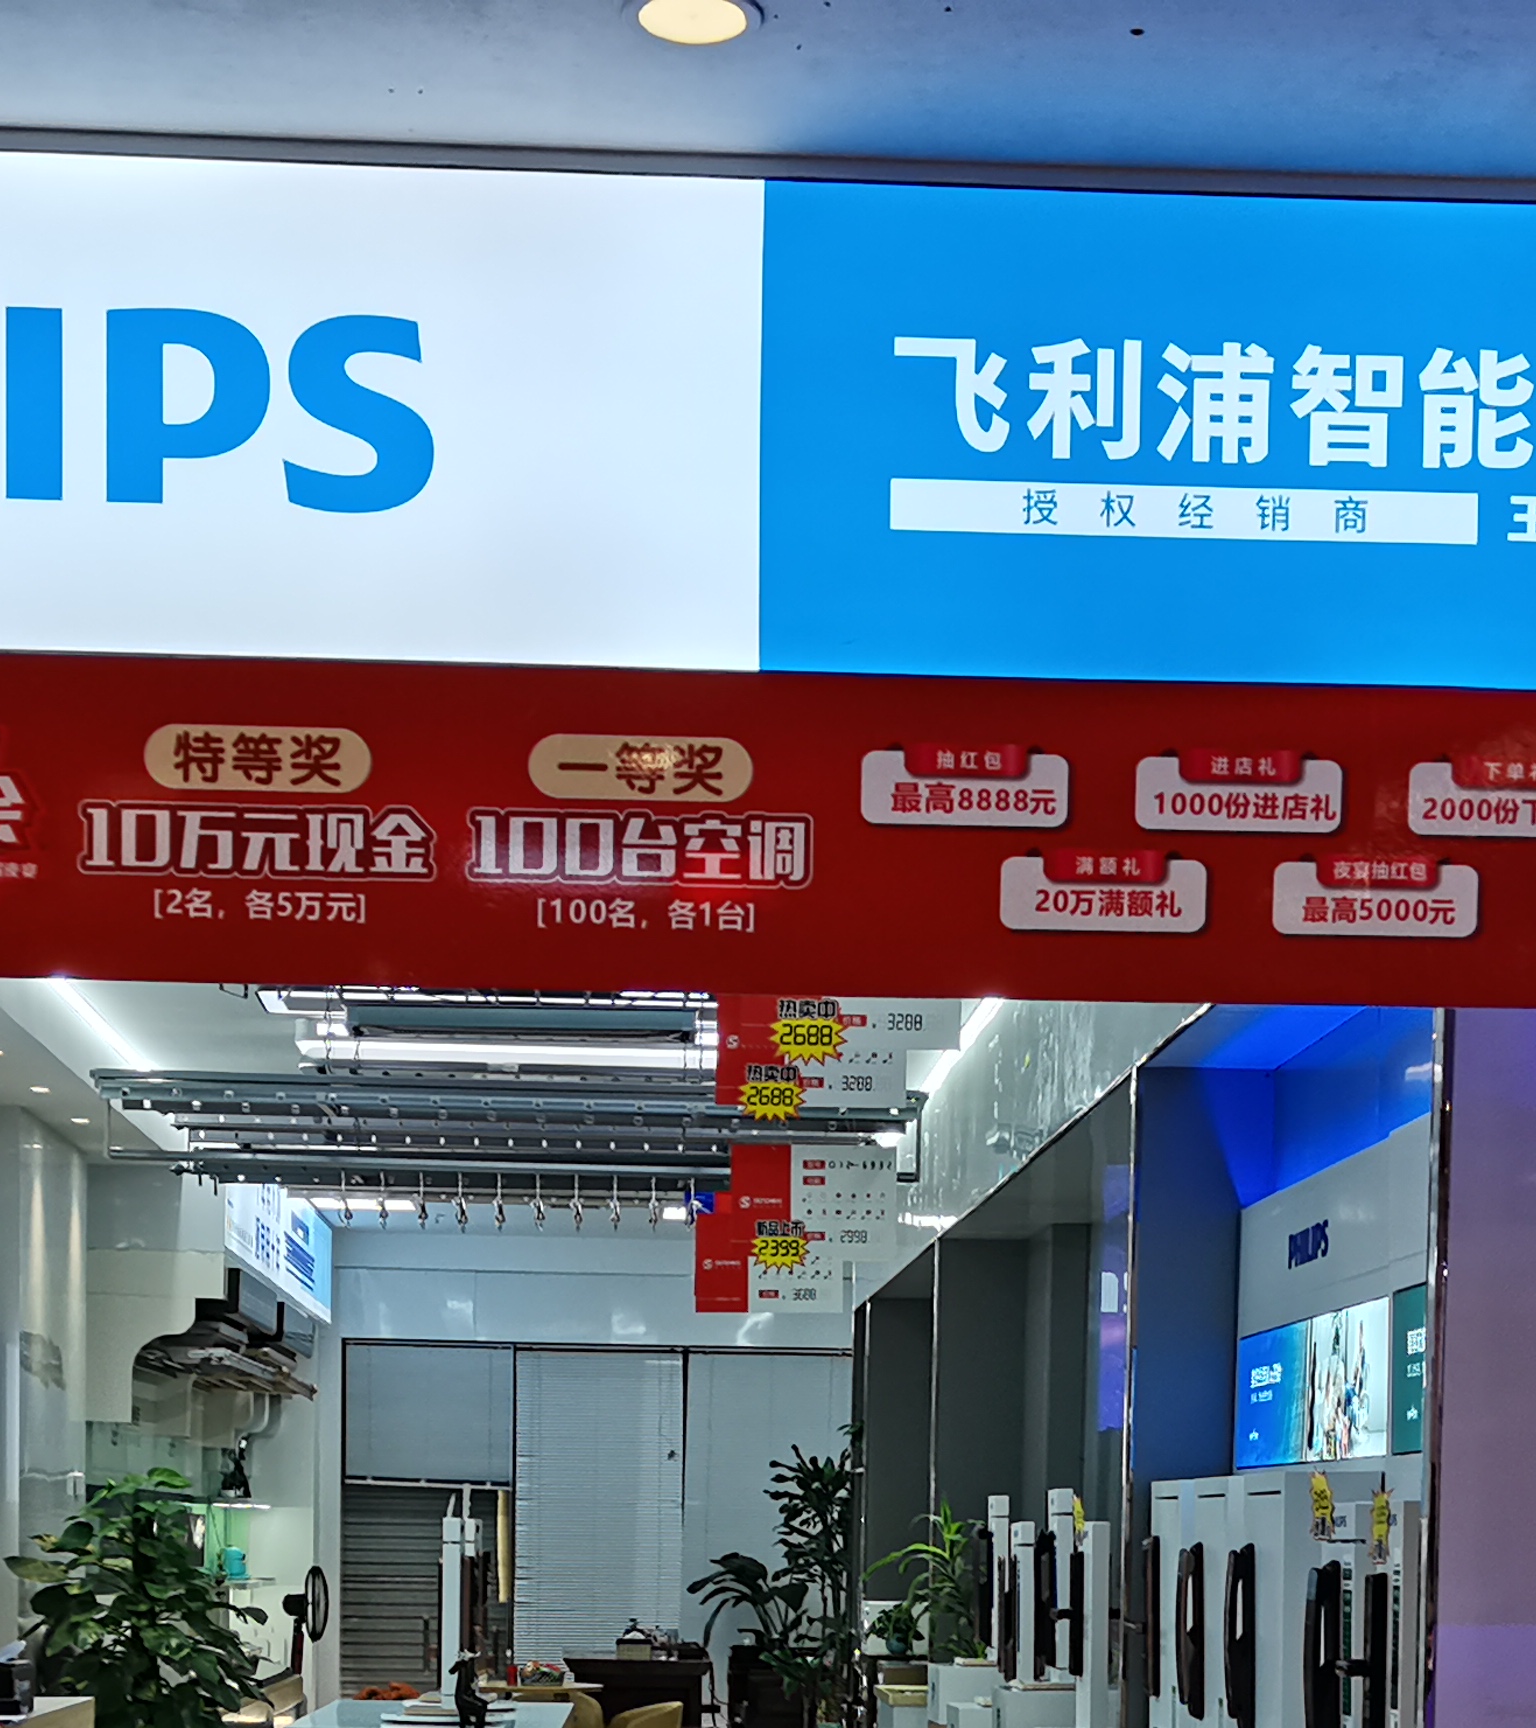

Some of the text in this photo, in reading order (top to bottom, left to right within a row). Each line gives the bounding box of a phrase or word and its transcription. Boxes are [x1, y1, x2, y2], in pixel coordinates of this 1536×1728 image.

[1022, 488, 1369, 535] 授权经销商
[173, 733, 342, 786] 特等奖
[556, 743, 724, 796] 一等奖
[937, 750, 1002, 771] 抽红包
[1211, 756, 1275, 777] 进店礼
[891, 783, 1057, 816] 最高8888元
[1154, 792, 1337, 822] 1000份进店礼
[83, 805, 434, 875] 10万元现金
[470, 811, 809, 882] 100台空调
[1075, 856, 1141, 877] 满额礼
[1333, 861, 1428, 882] 夜宴抽红包
[1035, 888, 1182, 918] 20万满额礼
[1302, 896, 1456, 926] 最高5000元
[780, 1023, 833, 1046] 2688
[746, 1086, 795, 1107] 2688
[758, 1239, 801, 1257] 2399
